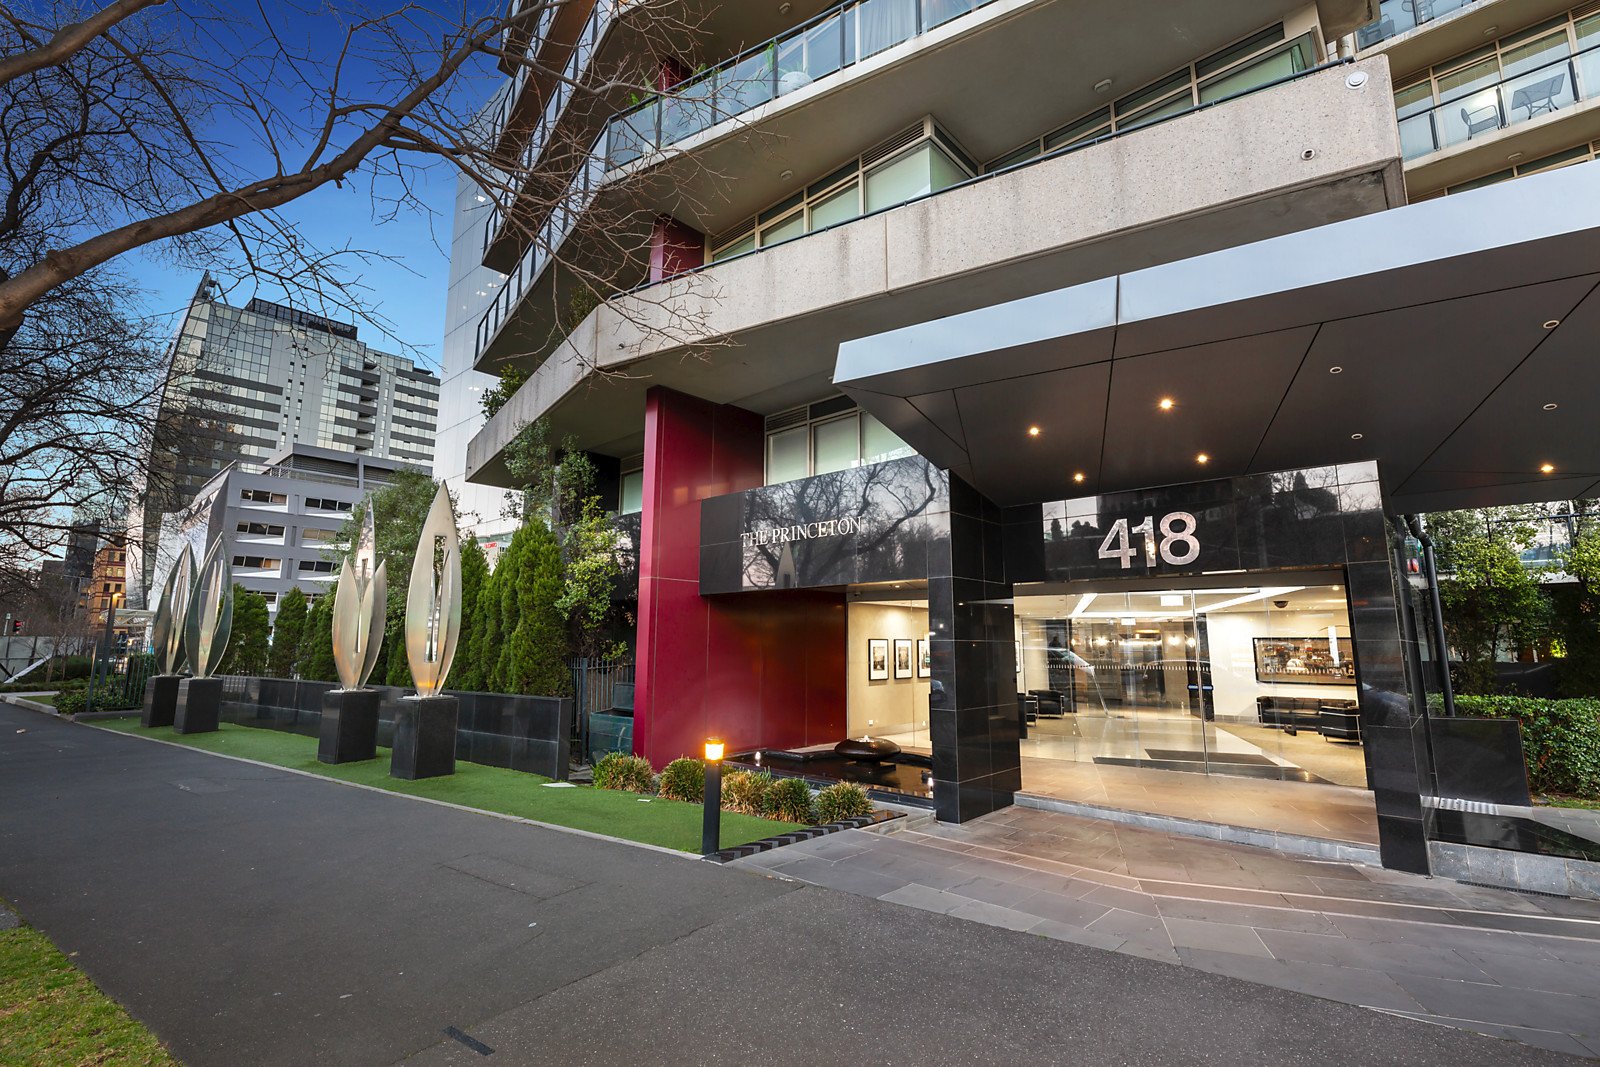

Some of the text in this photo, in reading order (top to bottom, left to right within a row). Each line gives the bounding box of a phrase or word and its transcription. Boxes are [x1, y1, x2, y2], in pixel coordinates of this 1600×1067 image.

[740, 516, 862, 548] THE PRINCETON
[1098, 511, 1200, 569] 418
